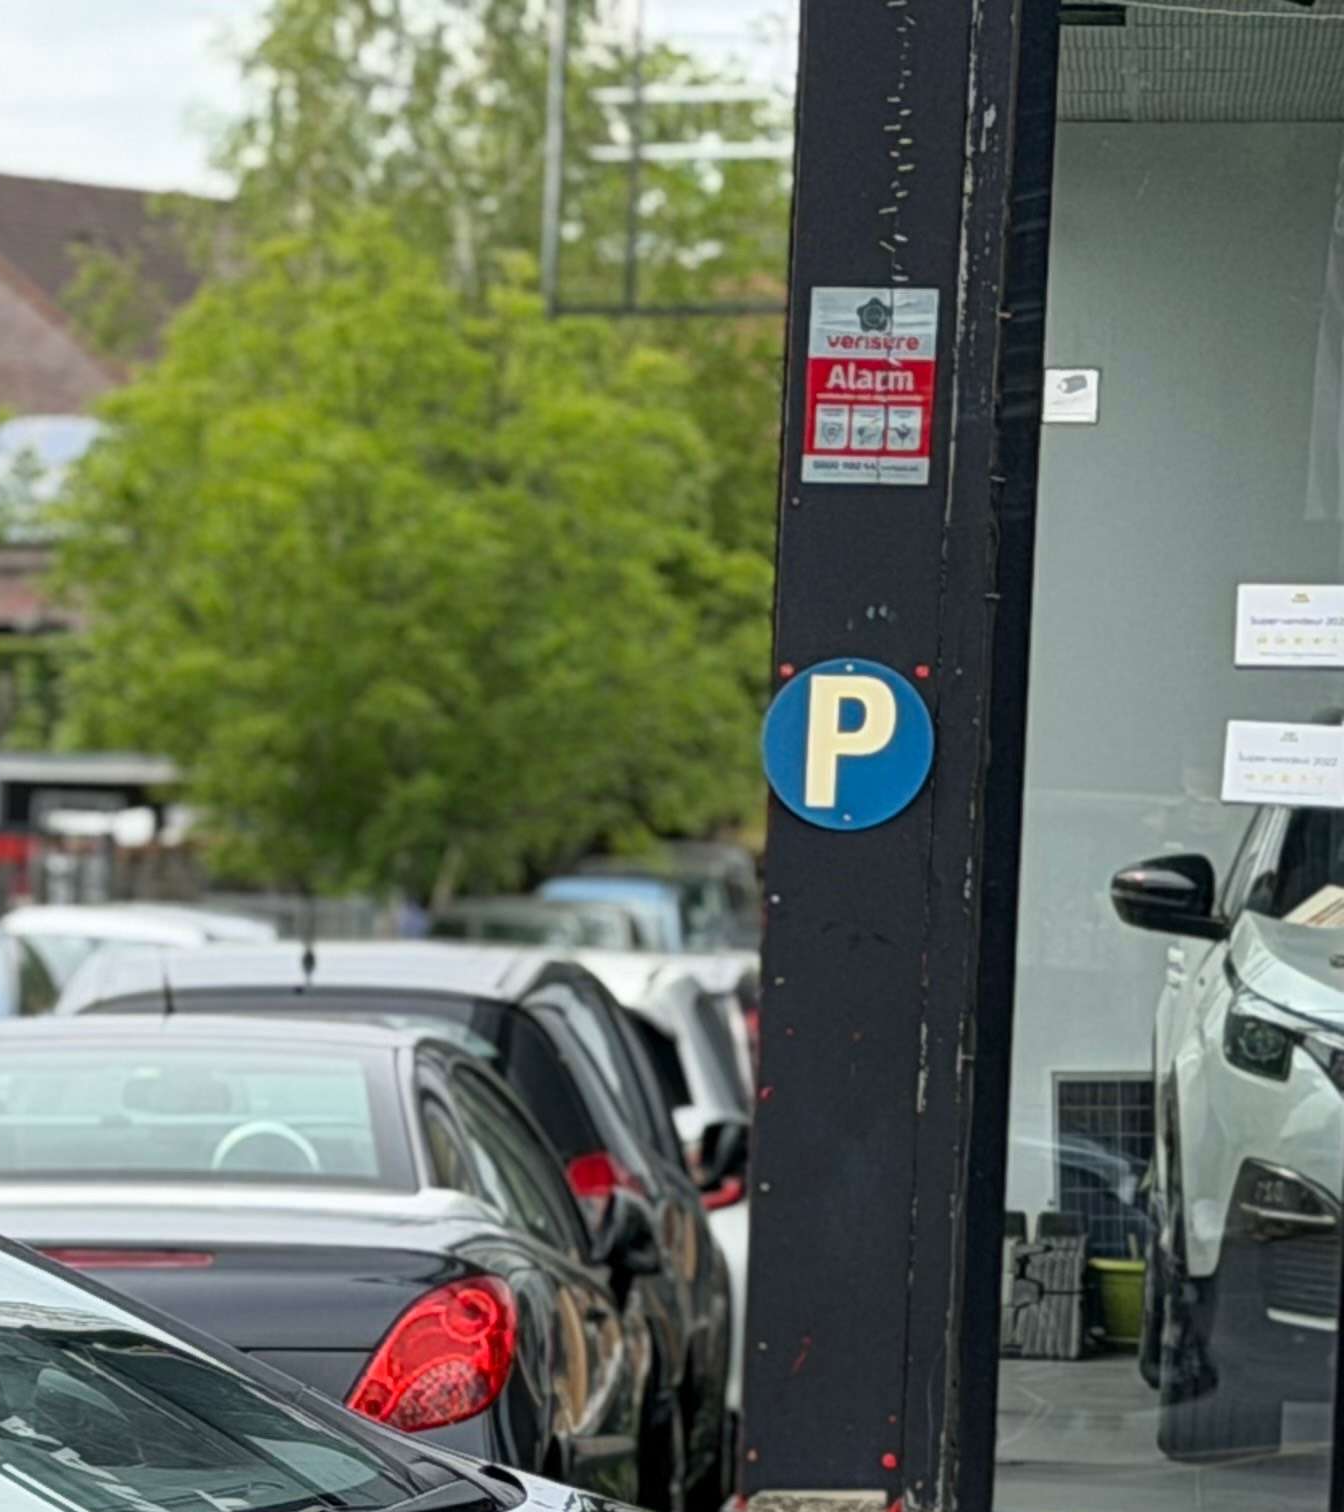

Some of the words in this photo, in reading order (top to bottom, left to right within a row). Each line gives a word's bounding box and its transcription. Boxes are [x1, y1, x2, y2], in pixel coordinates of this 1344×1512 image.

[826, 334, 920, 352] verisure
[825, 362, 915, 392] Alarm
[804, 674, 897, 809] P
